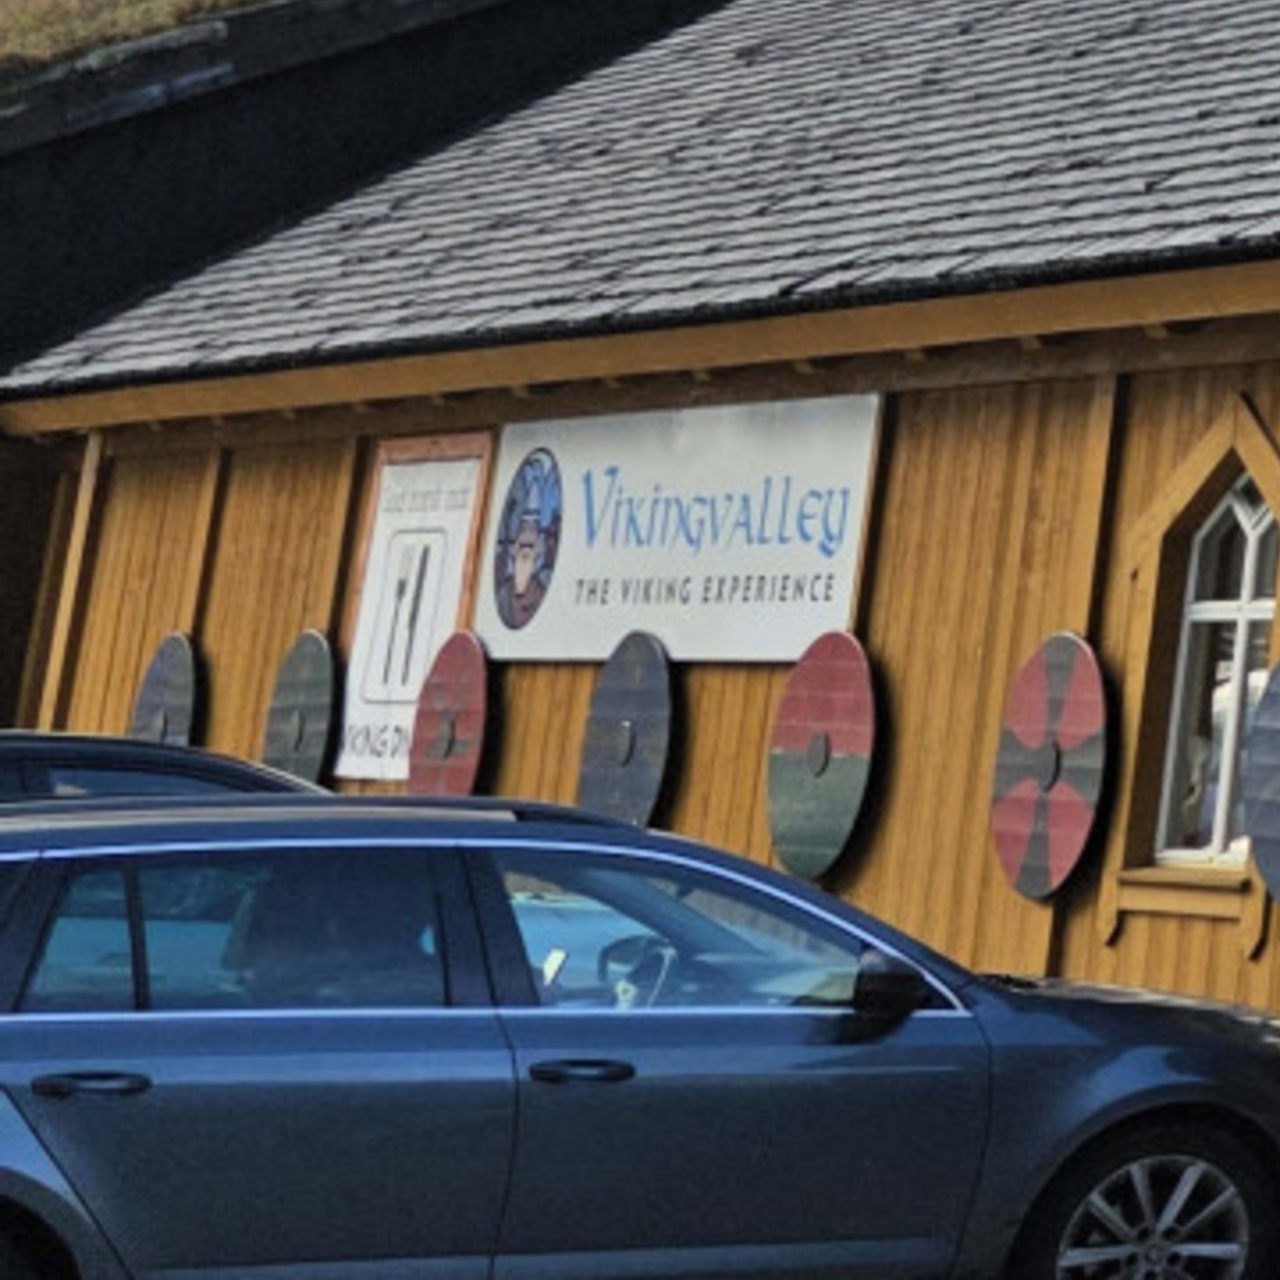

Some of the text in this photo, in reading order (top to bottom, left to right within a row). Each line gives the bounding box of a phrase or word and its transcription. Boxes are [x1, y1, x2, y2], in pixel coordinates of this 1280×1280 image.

[574, 572, 836, 607] THE VIKING EXPERIENCE
